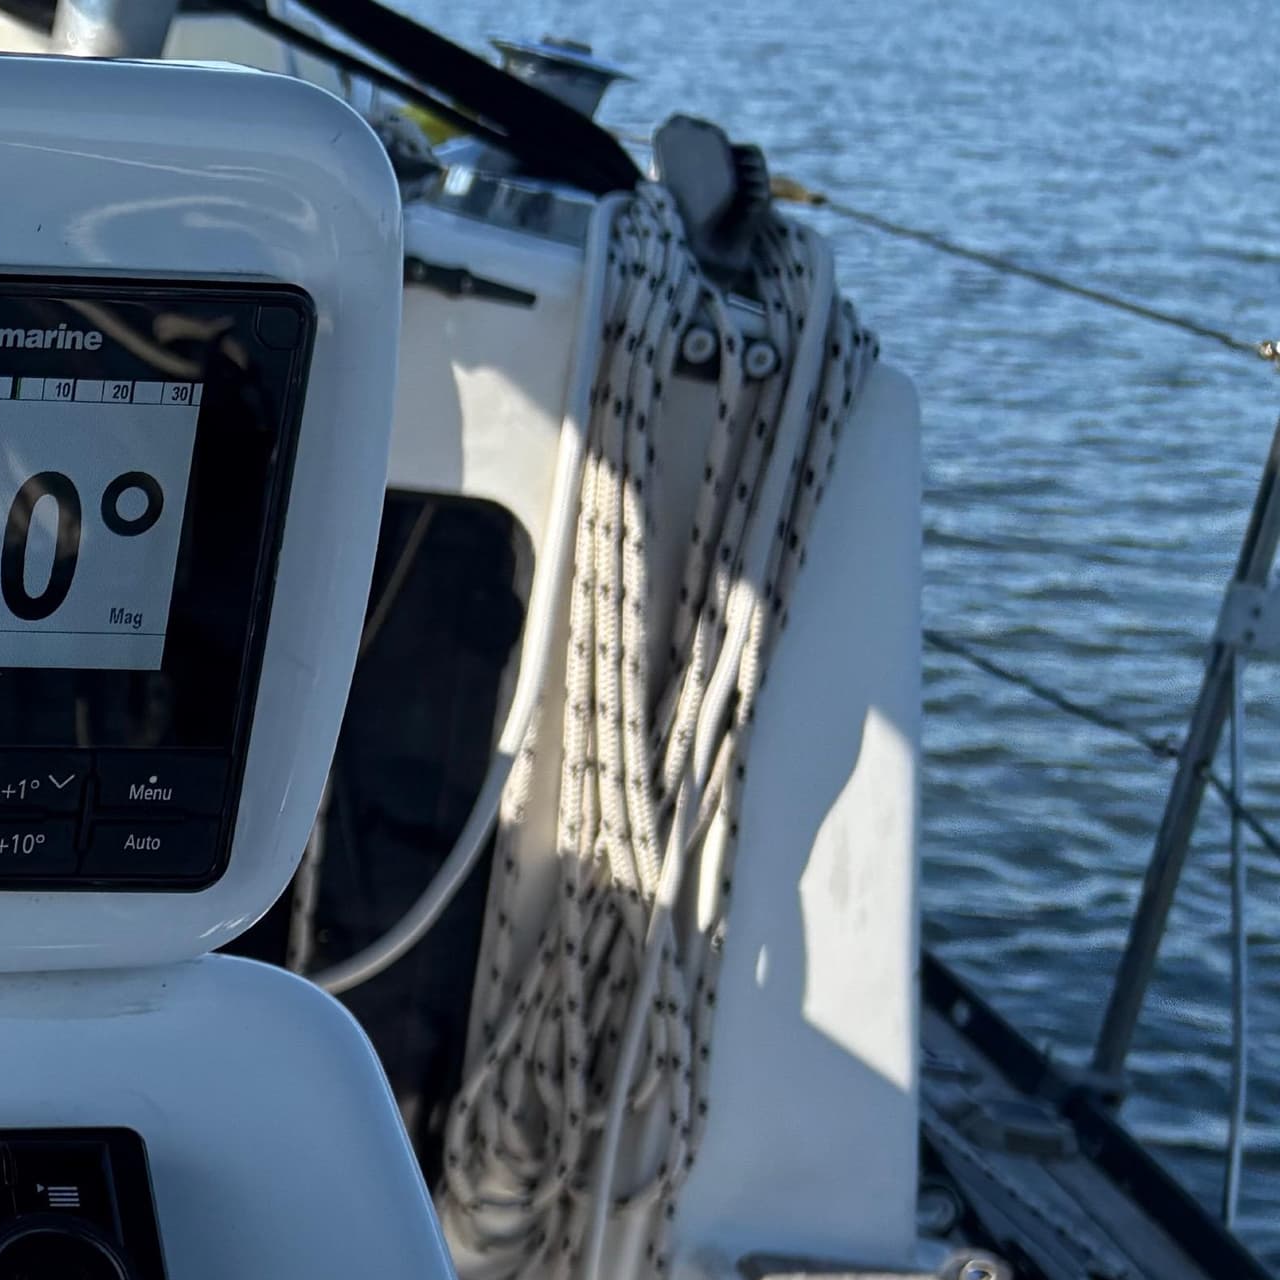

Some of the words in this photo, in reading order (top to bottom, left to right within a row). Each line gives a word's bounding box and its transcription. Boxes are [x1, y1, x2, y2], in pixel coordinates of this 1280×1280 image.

[55, 382, 72, 397] 10
[112, 384, 130, 400] 20
[171, 386, 189, 402] 30
[109, 608, 143, 628] Mag
[1, 779, 40, 799] +1°
[129, 783, 172, 801] Menu
[124, 834, 161, 851] Auto
